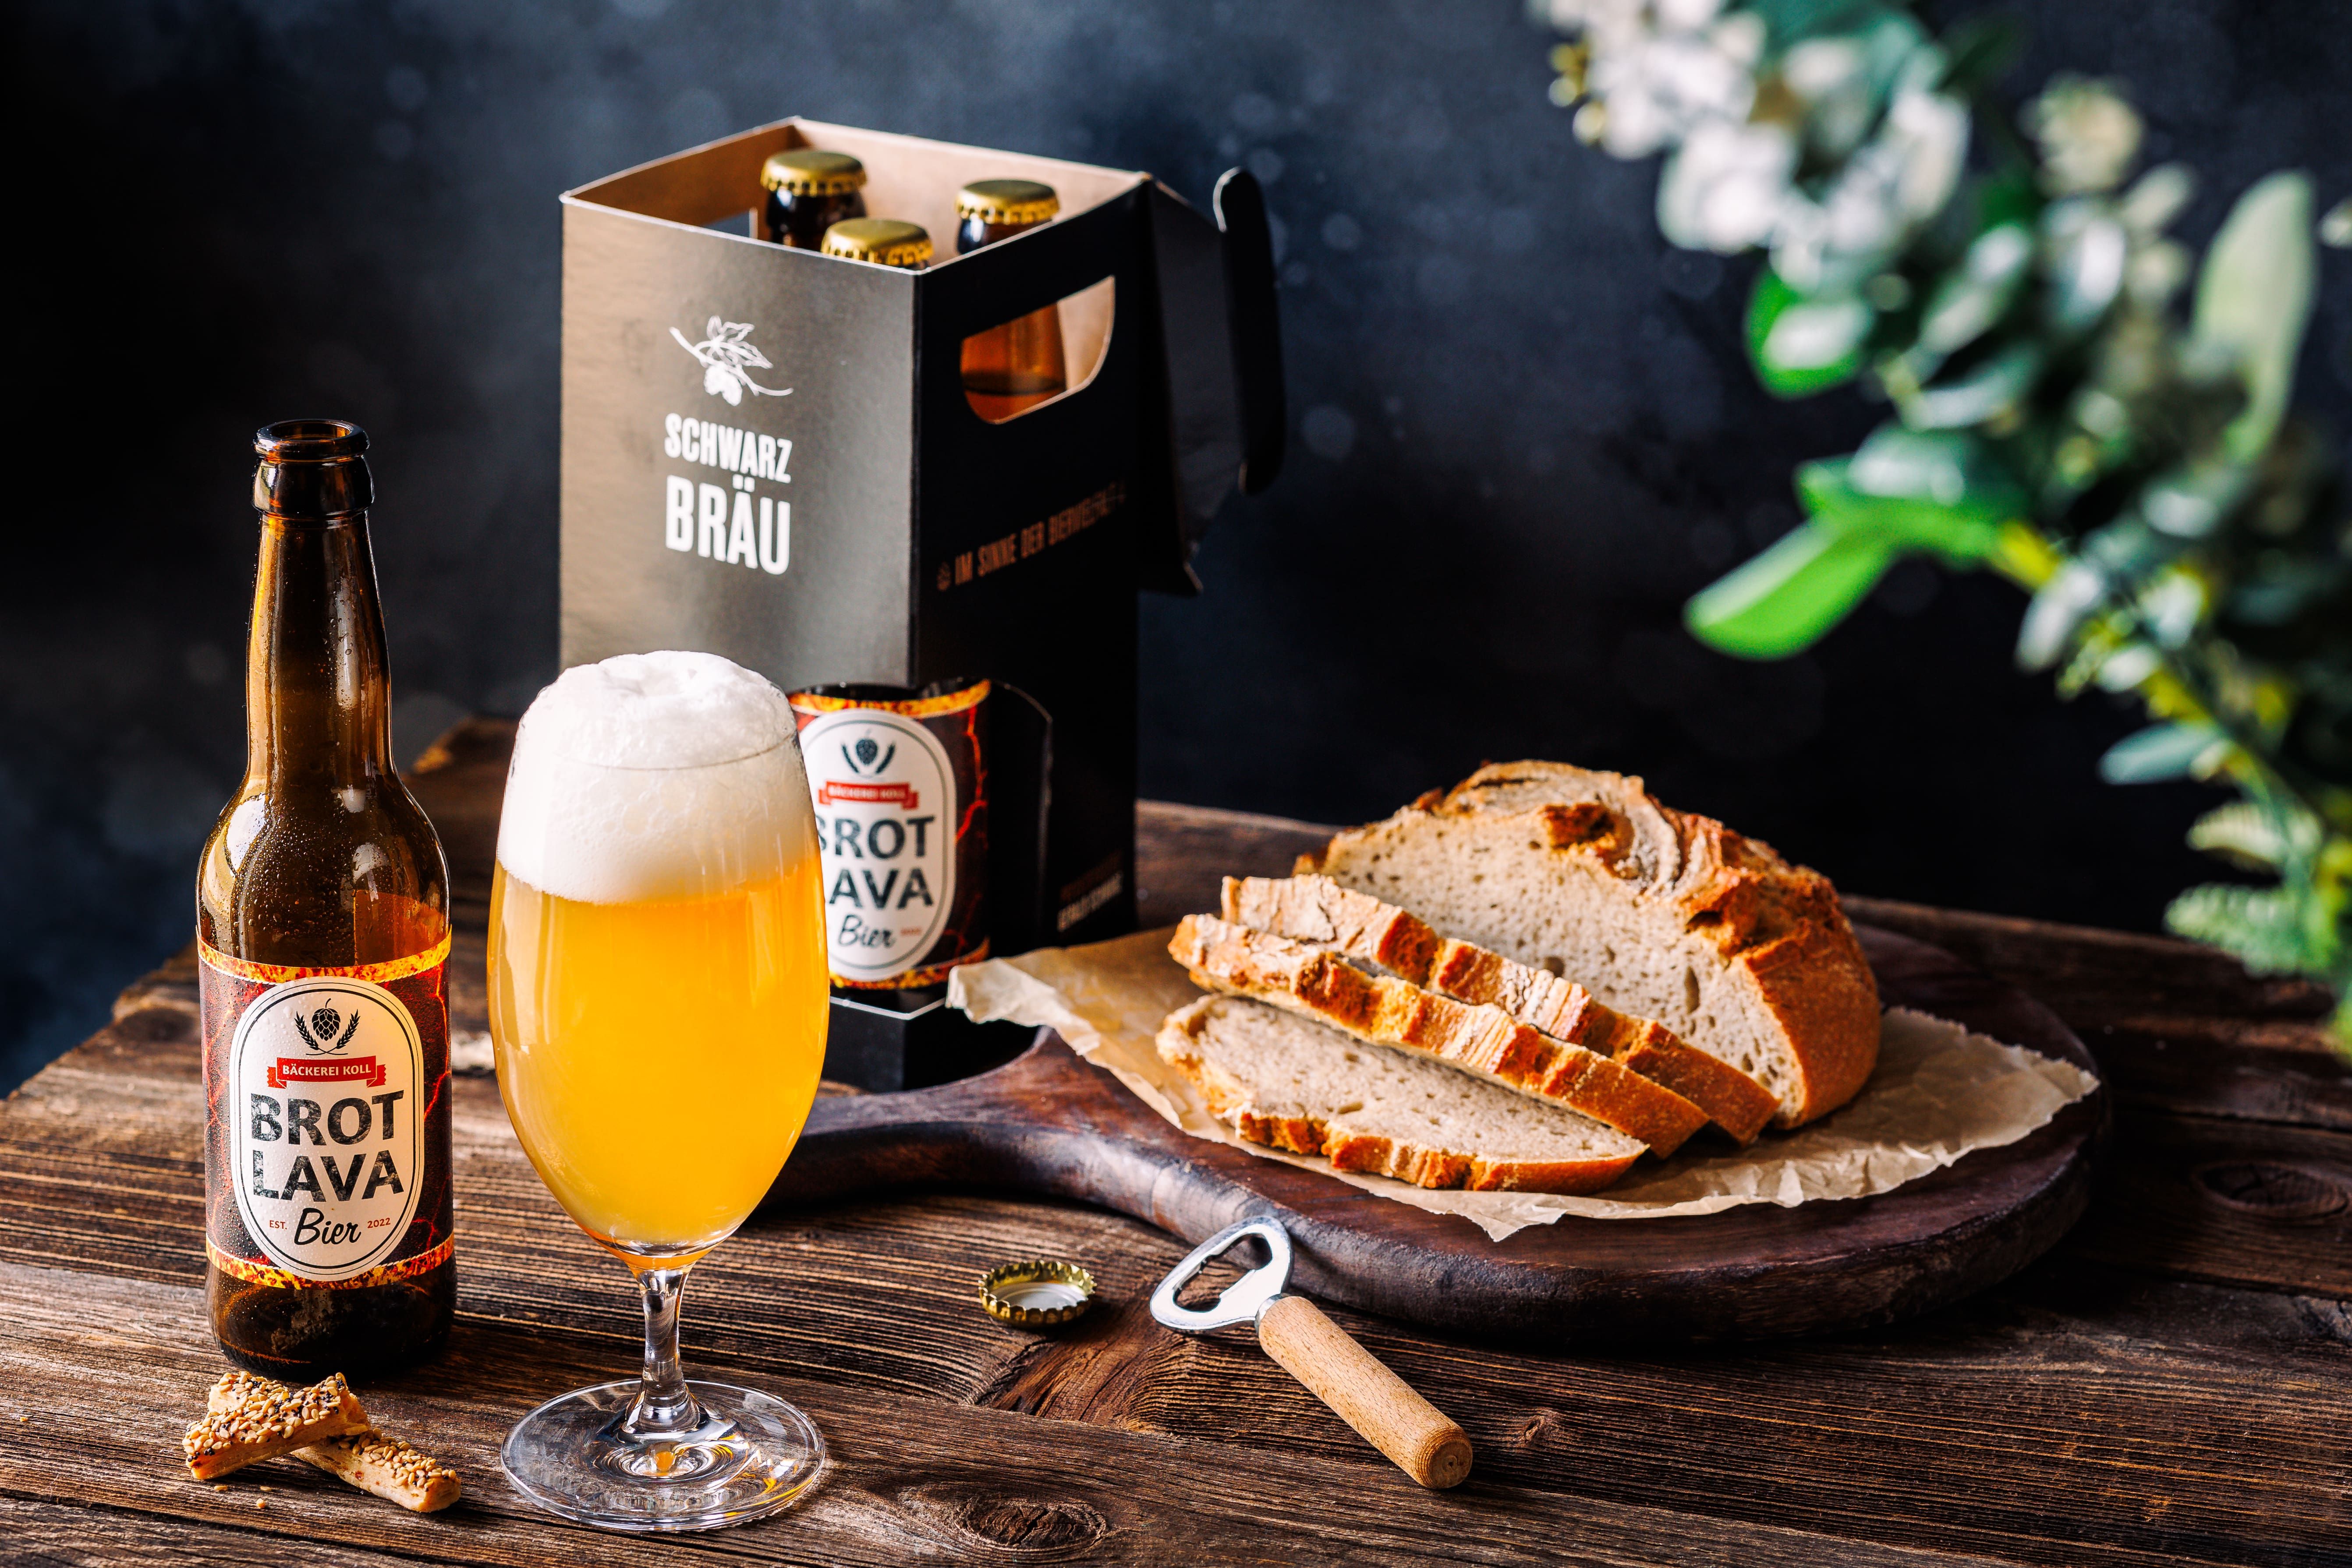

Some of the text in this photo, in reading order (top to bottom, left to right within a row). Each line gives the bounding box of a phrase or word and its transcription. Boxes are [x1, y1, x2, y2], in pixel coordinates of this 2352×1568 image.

[664, 412, 792, 484] SCHWARZ
[666, 474, 790, 575] BRÄU
[829, 868, 934, 910] AVA
[839, 913, 896, 949] Bier
[283, 1063, 371, 1076] BÄCKEREI KOLL
[251, 1090, 404, 1146] BROT
[253, 1150, 404, 1202] LAVA
[269, 1207, 391, 1245] EST. Bier 2022
